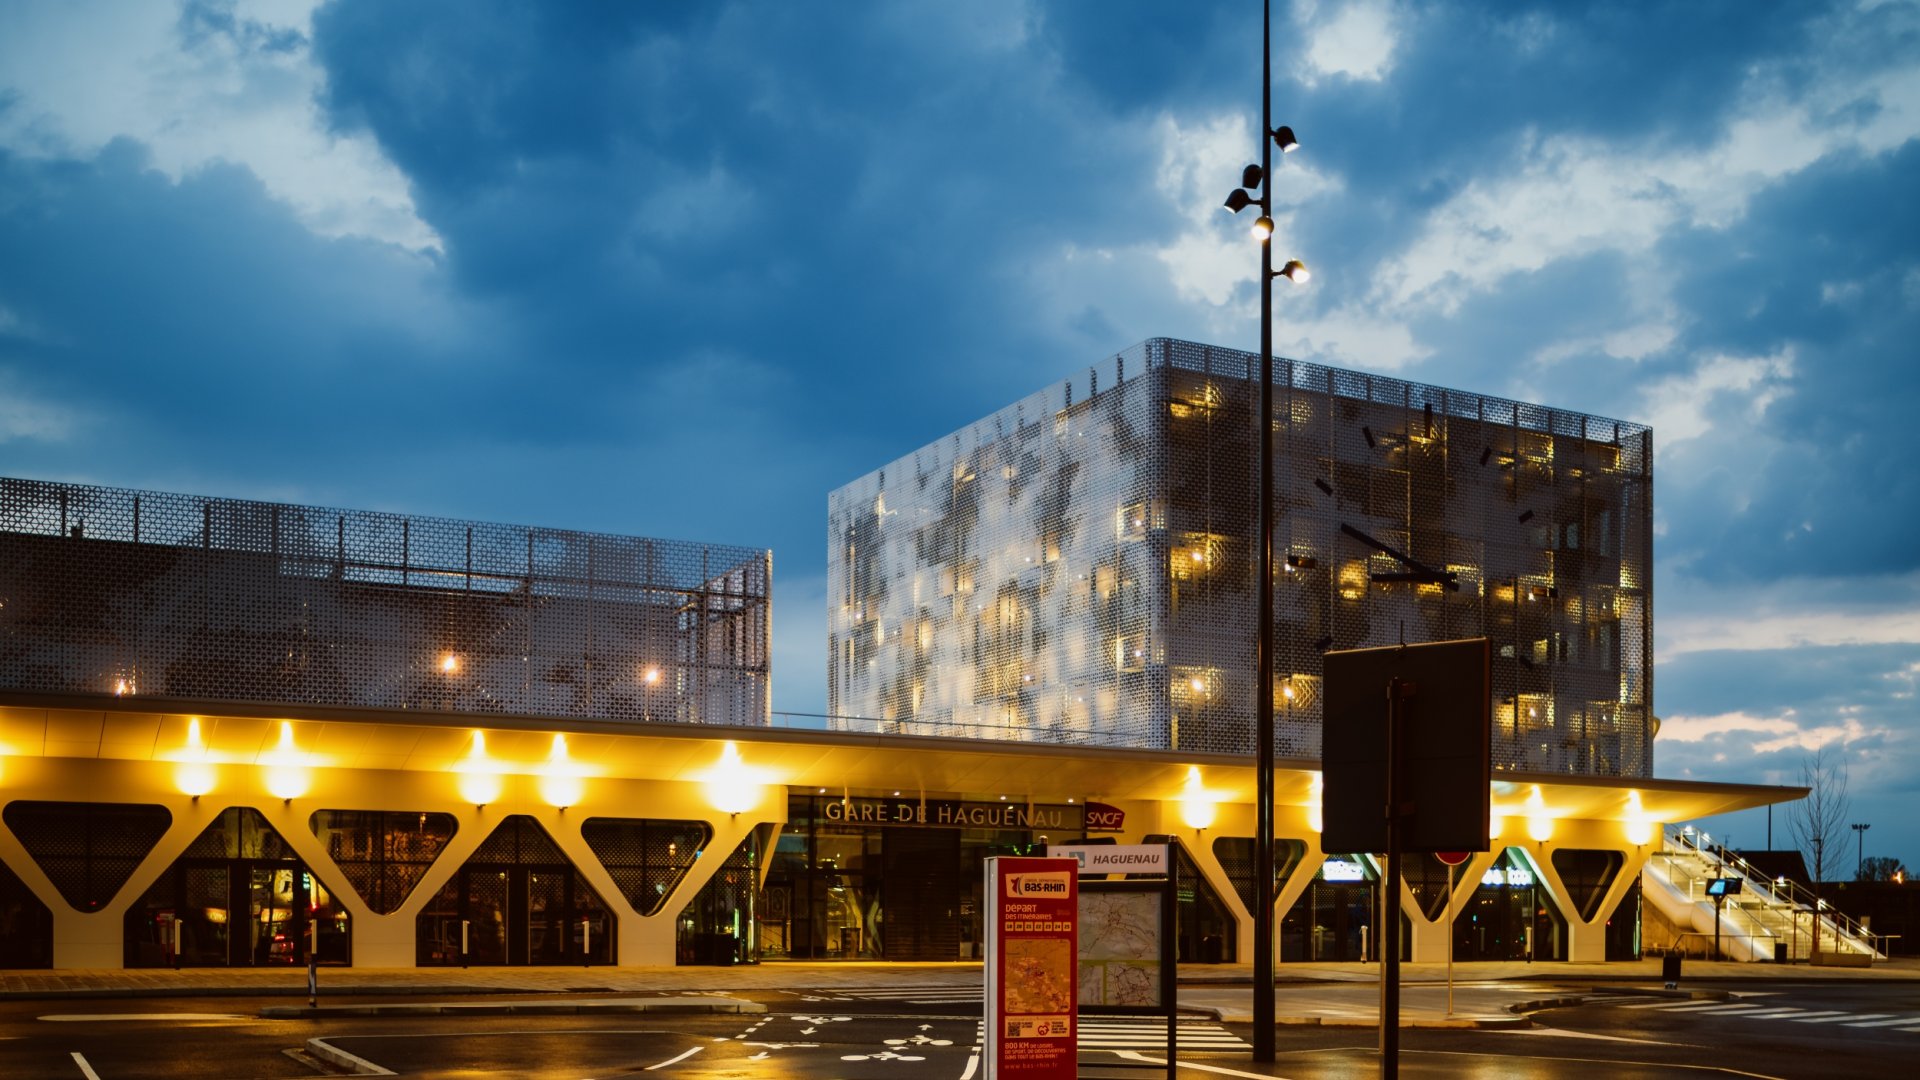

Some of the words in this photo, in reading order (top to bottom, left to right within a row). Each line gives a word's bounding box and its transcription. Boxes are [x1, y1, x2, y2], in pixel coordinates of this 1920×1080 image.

[825, 802, 888, 821] GARE
[899, 803, 927, 823] DE
[938, 806, 1061, 827] HAGUENAU
[1086, 811, 1122, 825] SNCF
[1093, 854, 1160, 864] HAGUENAU
[1004, 1042, 1018, 1050] 800
